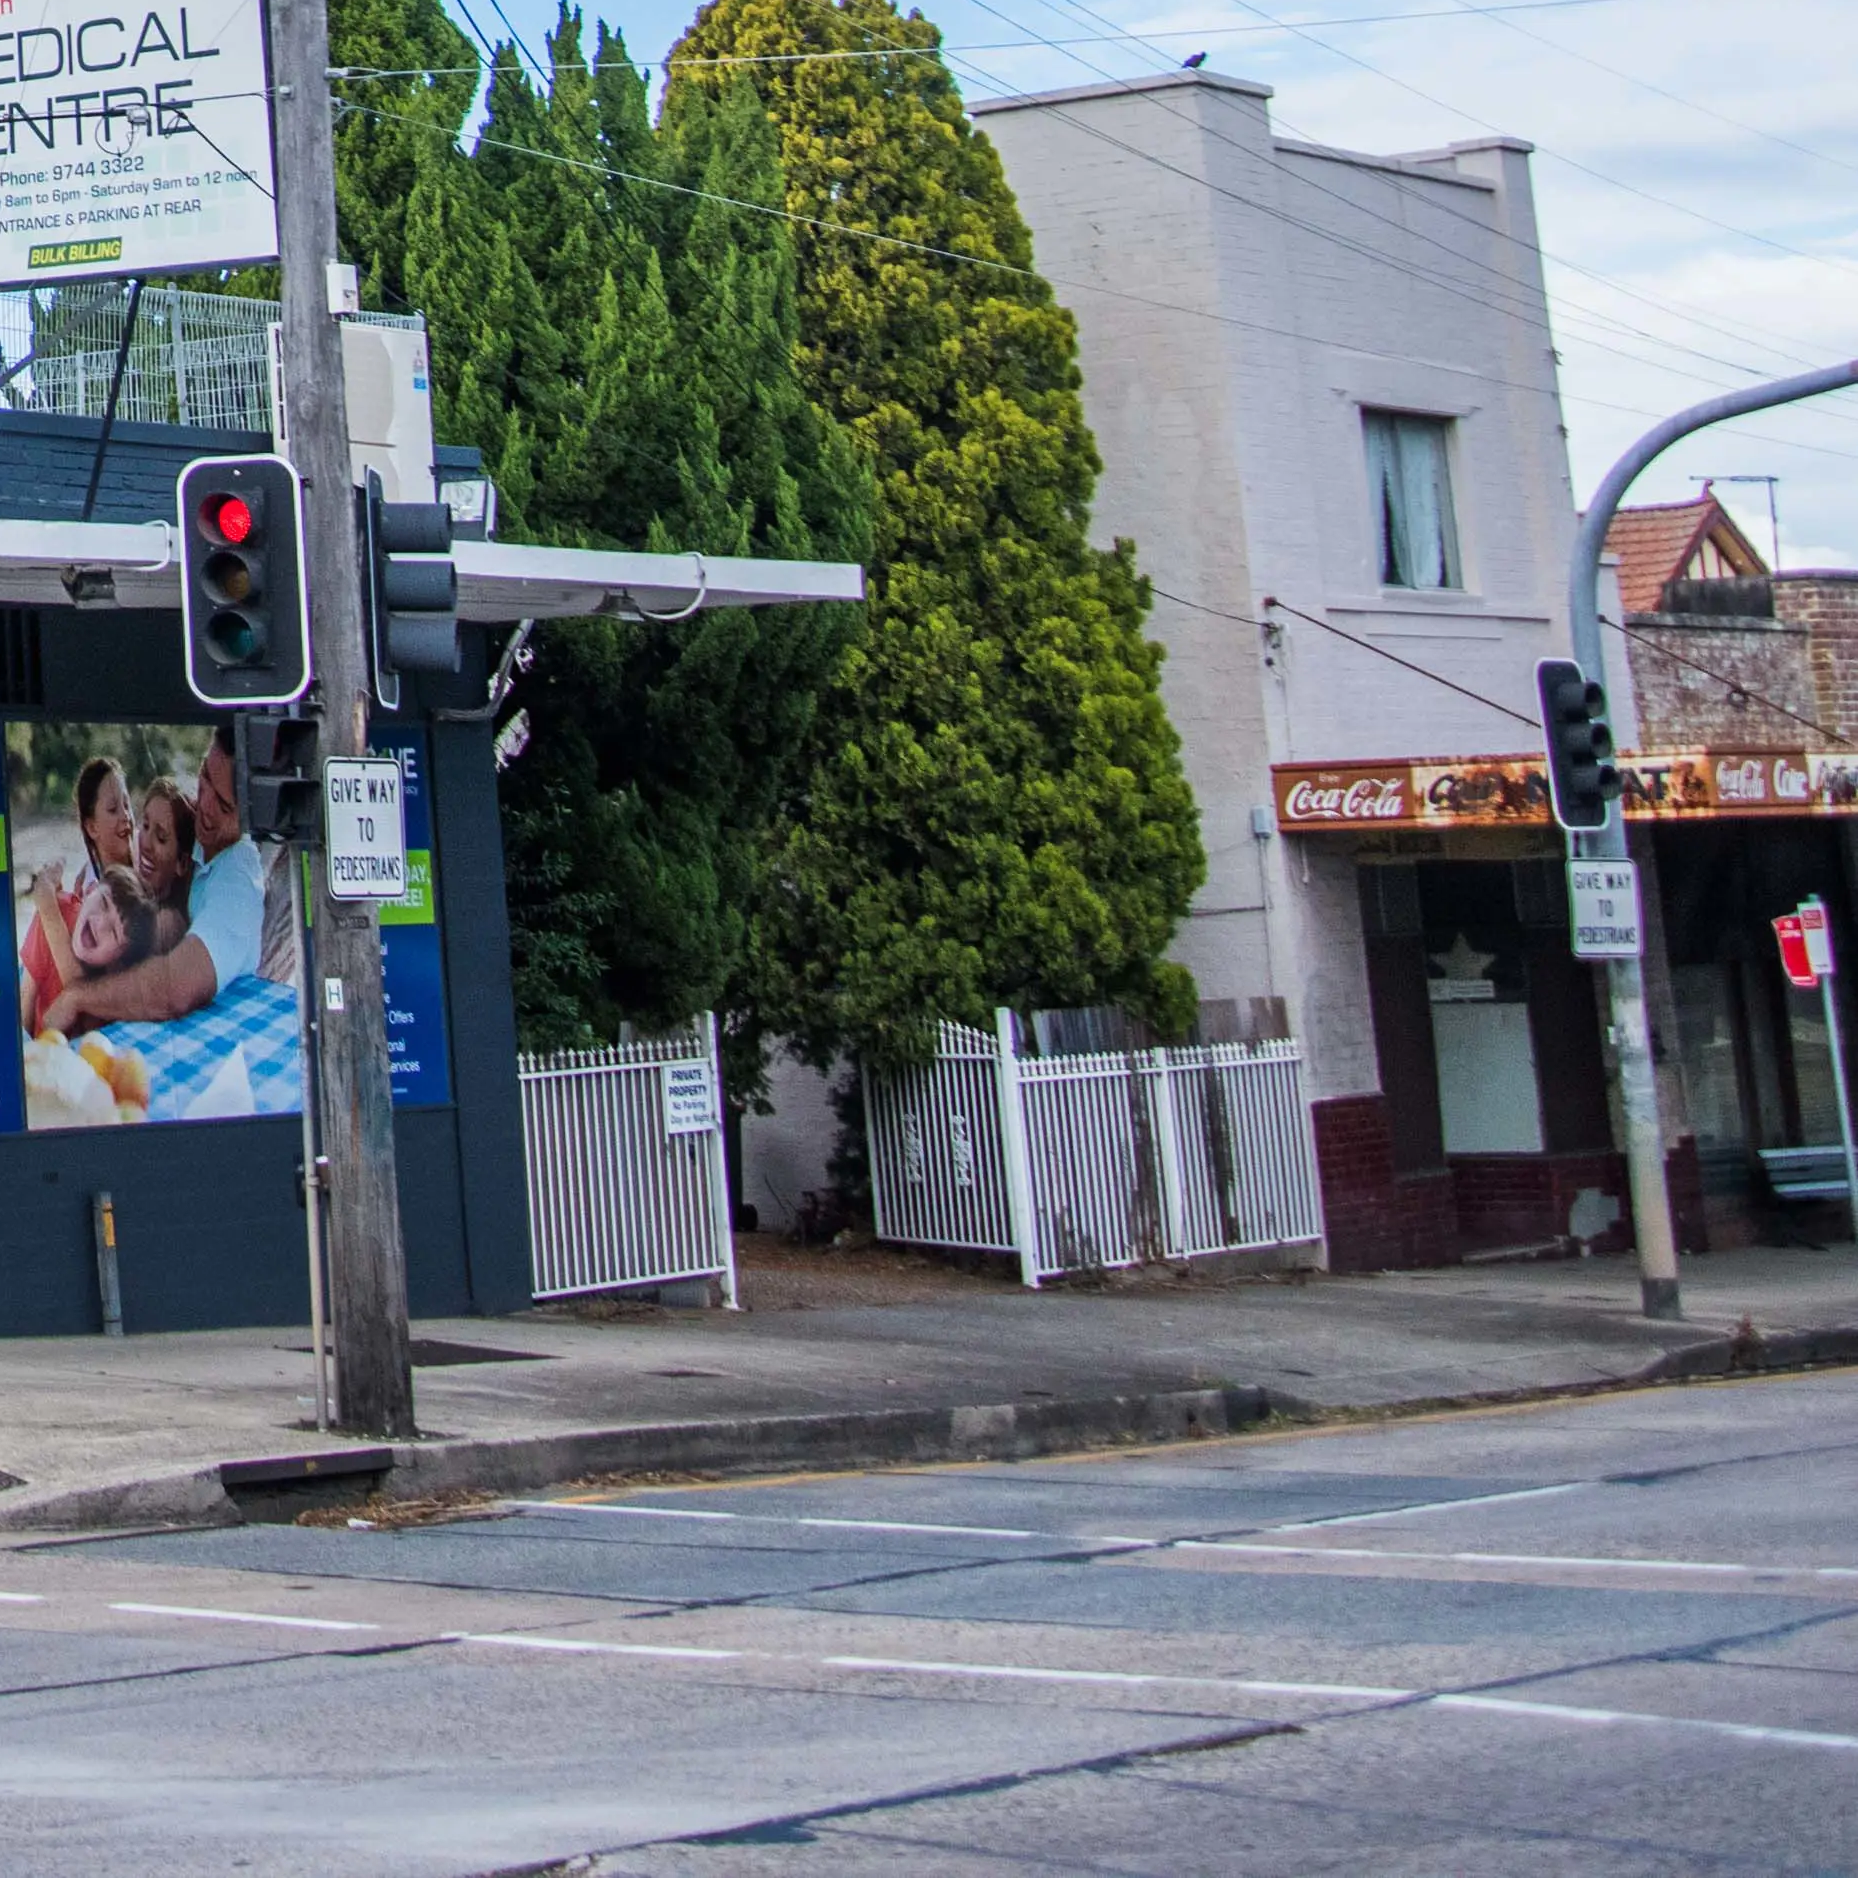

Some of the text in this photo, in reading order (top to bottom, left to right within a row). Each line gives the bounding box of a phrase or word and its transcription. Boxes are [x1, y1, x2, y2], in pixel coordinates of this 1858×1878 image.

[0, 156, 145, 188] Phone: 9744 3322
[35, 192, 50, 205] to
[91, 181, 149, 200] Saturday
[152, 177, 183, 193] 9am
[186, 175, 201, 187] to
[203, 171, 222, 185] 12
[225, 169, 258, 183] noon
[65, 214, 76, 227] &
[78, 207, 142, 226] PARKING
[143, 204, 162, 218] AT
[164, 199, 202, 215] REAR
[30, 239, 122, 266] BULK BILLING
[330, 777, 362, 804] GIVE
[367, 779, 396, 804] WAY
[356, 817, 375, 842] TO
[333, 856, 401, 882] PEDESTRIANS
[1575, 872, 1631, 890] GIVE WAY
[1597, 899, 1614, 918] TO
[1577, 926, 1636, 945] PEDESTRIANS
[327, 985, 342, 1004] H
